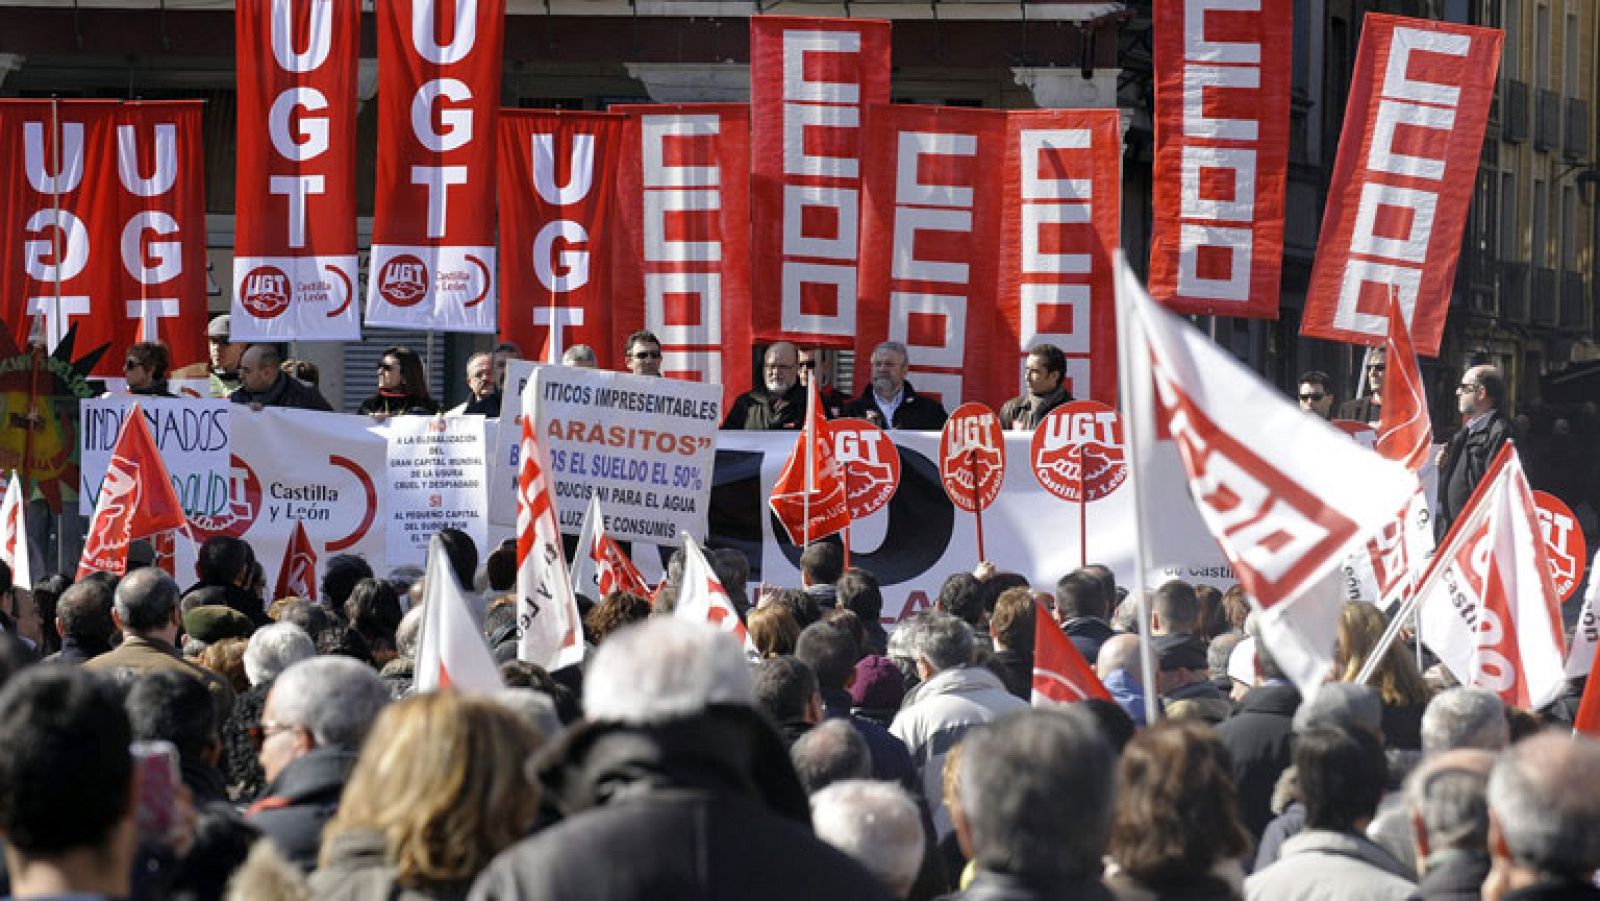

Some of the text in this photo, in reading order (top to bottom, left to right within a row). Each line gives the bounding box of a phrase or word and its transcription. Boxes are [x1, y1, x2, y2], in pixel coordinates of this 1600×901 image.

[269, 0, 333, 248] UGT
[410, 0, 475, 239] UGT
[781, 29, 861, 337] CCOO
[117, 124, 182, 344] UGT
[532, 133, 595, 364] UGT
[247, 275, 284, 296] UGT
[384, 264, 423, 284] UGT
[595, 387, 718, 421] IMPRESENTABLES
[830, 431, 882, 466] GT
[947, 413, 995, 458] UGT
[1045, 412, 1117, 450] UGT
[414, 458, 447, 468] CAPITAL
[570, 451, 586, 475] EL
[592, 454, 649, 482] SUELDO
[652, 462, 668, 486] EL
[673, 464, 703, 490] 50%
[270, 482, 338, 501] Castilla
[611, 488, 642, 507] PARA
[645, 491, 659, 509] EL
[663, 494, 697, 514] AGUA
[270, 502, 330, 521] y León
[560, 510, 584, 527] LUZ
